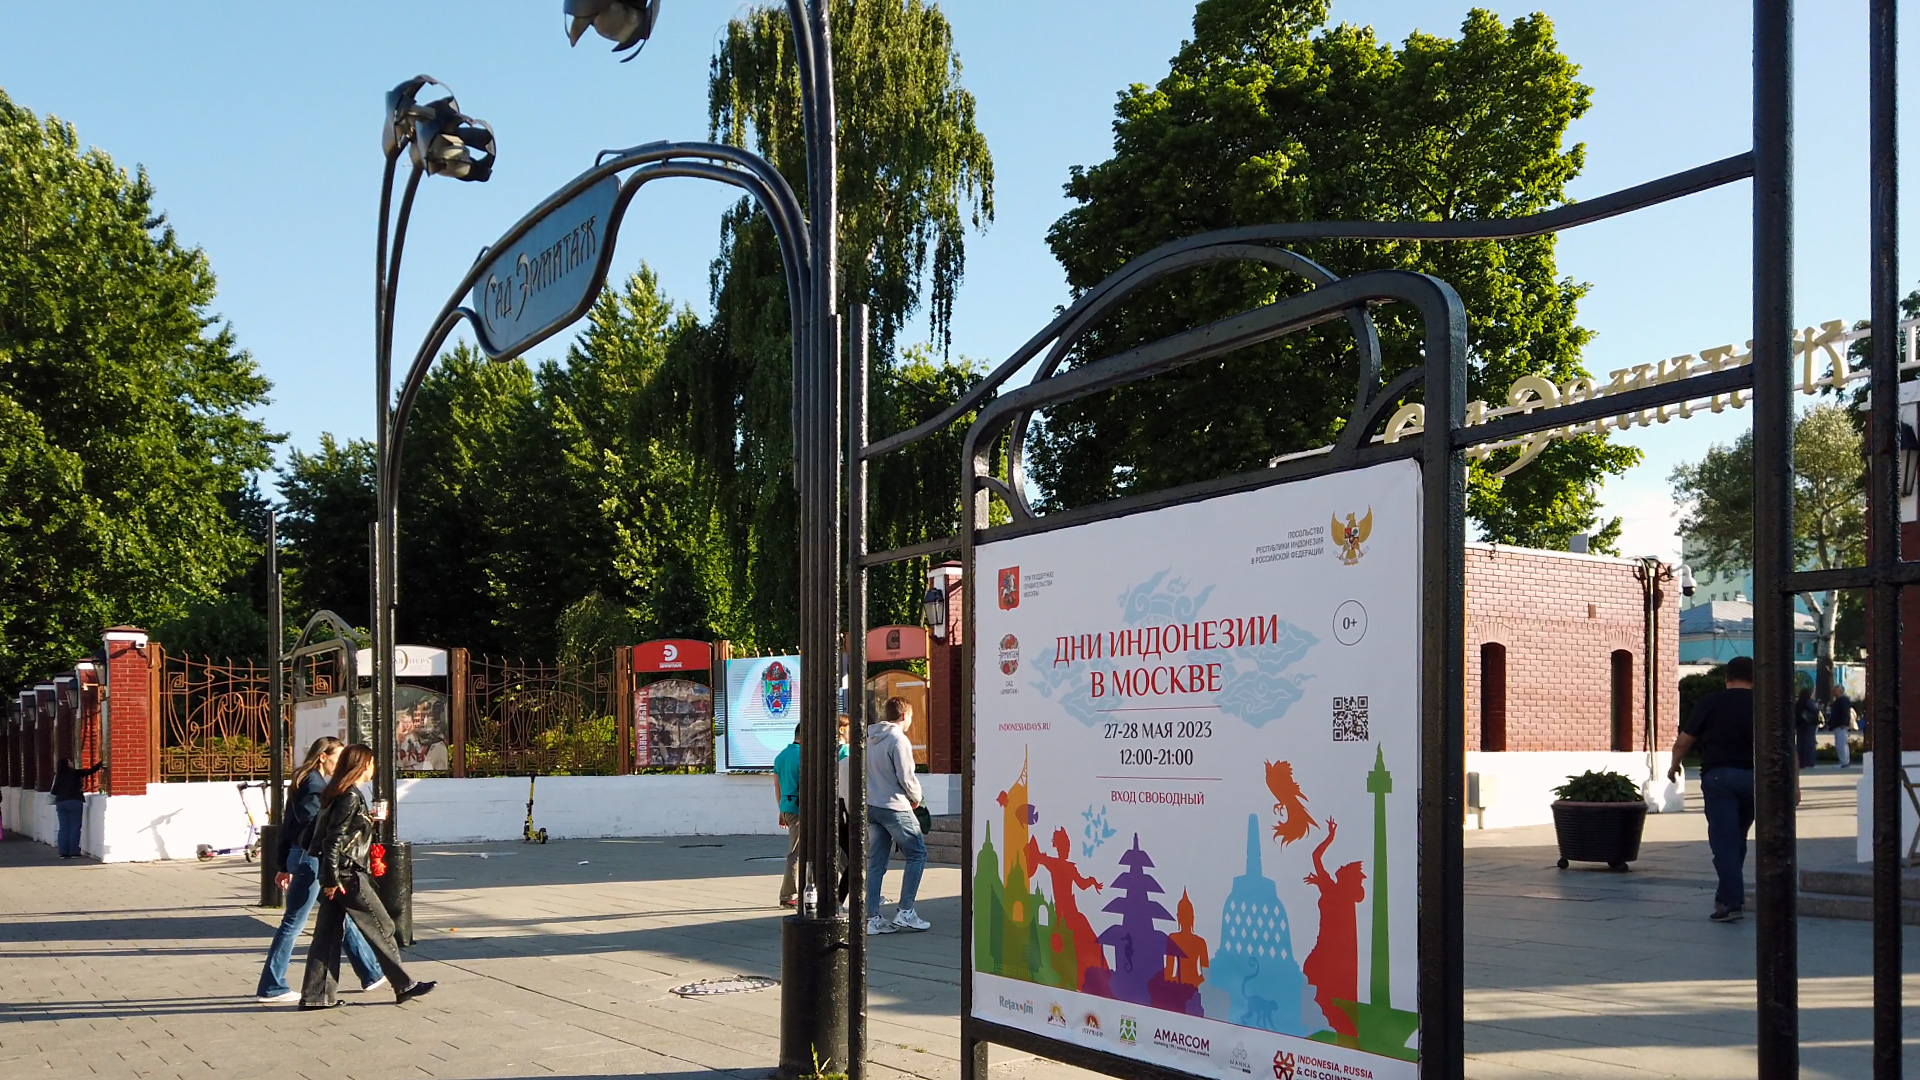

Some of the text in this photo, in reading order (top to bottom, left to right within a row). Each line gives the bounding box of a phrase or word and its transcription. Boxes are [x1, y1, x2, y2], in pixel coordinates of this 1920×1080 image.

[1287, 526, 1324, 539] ПОСОЛЬСТВО
[1256, 542, 1290, 554] РЕСПУБЛИКИ
[1290, 547, 1324, 559] ФЕДЕРАЦИИ
[1342, 615, 1358, 630] 0+
[1053, 614, 1278, 668] ДНИ ИНДОНЕЗИИ
[1090, 663, 1223, 697] В МОСКВЕ
[998, 722, 1051, 732] INDONESIADAYS.RU
[1104, 721, 1212, 739] 27-28 МАЯ 2023
[1119, 748, 1194, 766] 12:00-21:00
[1110, 790, 1205, 805] ВХОД СВОБОДНЫЙ
[1153, 1028, 1210, 1052] AMARCOM
[1296, 1067, 1303, 1076] &
[1304, 1068, 1318, 1079] CIS
[1297, 1054, 1373, 1079] INDONESIA, RUSSIA
